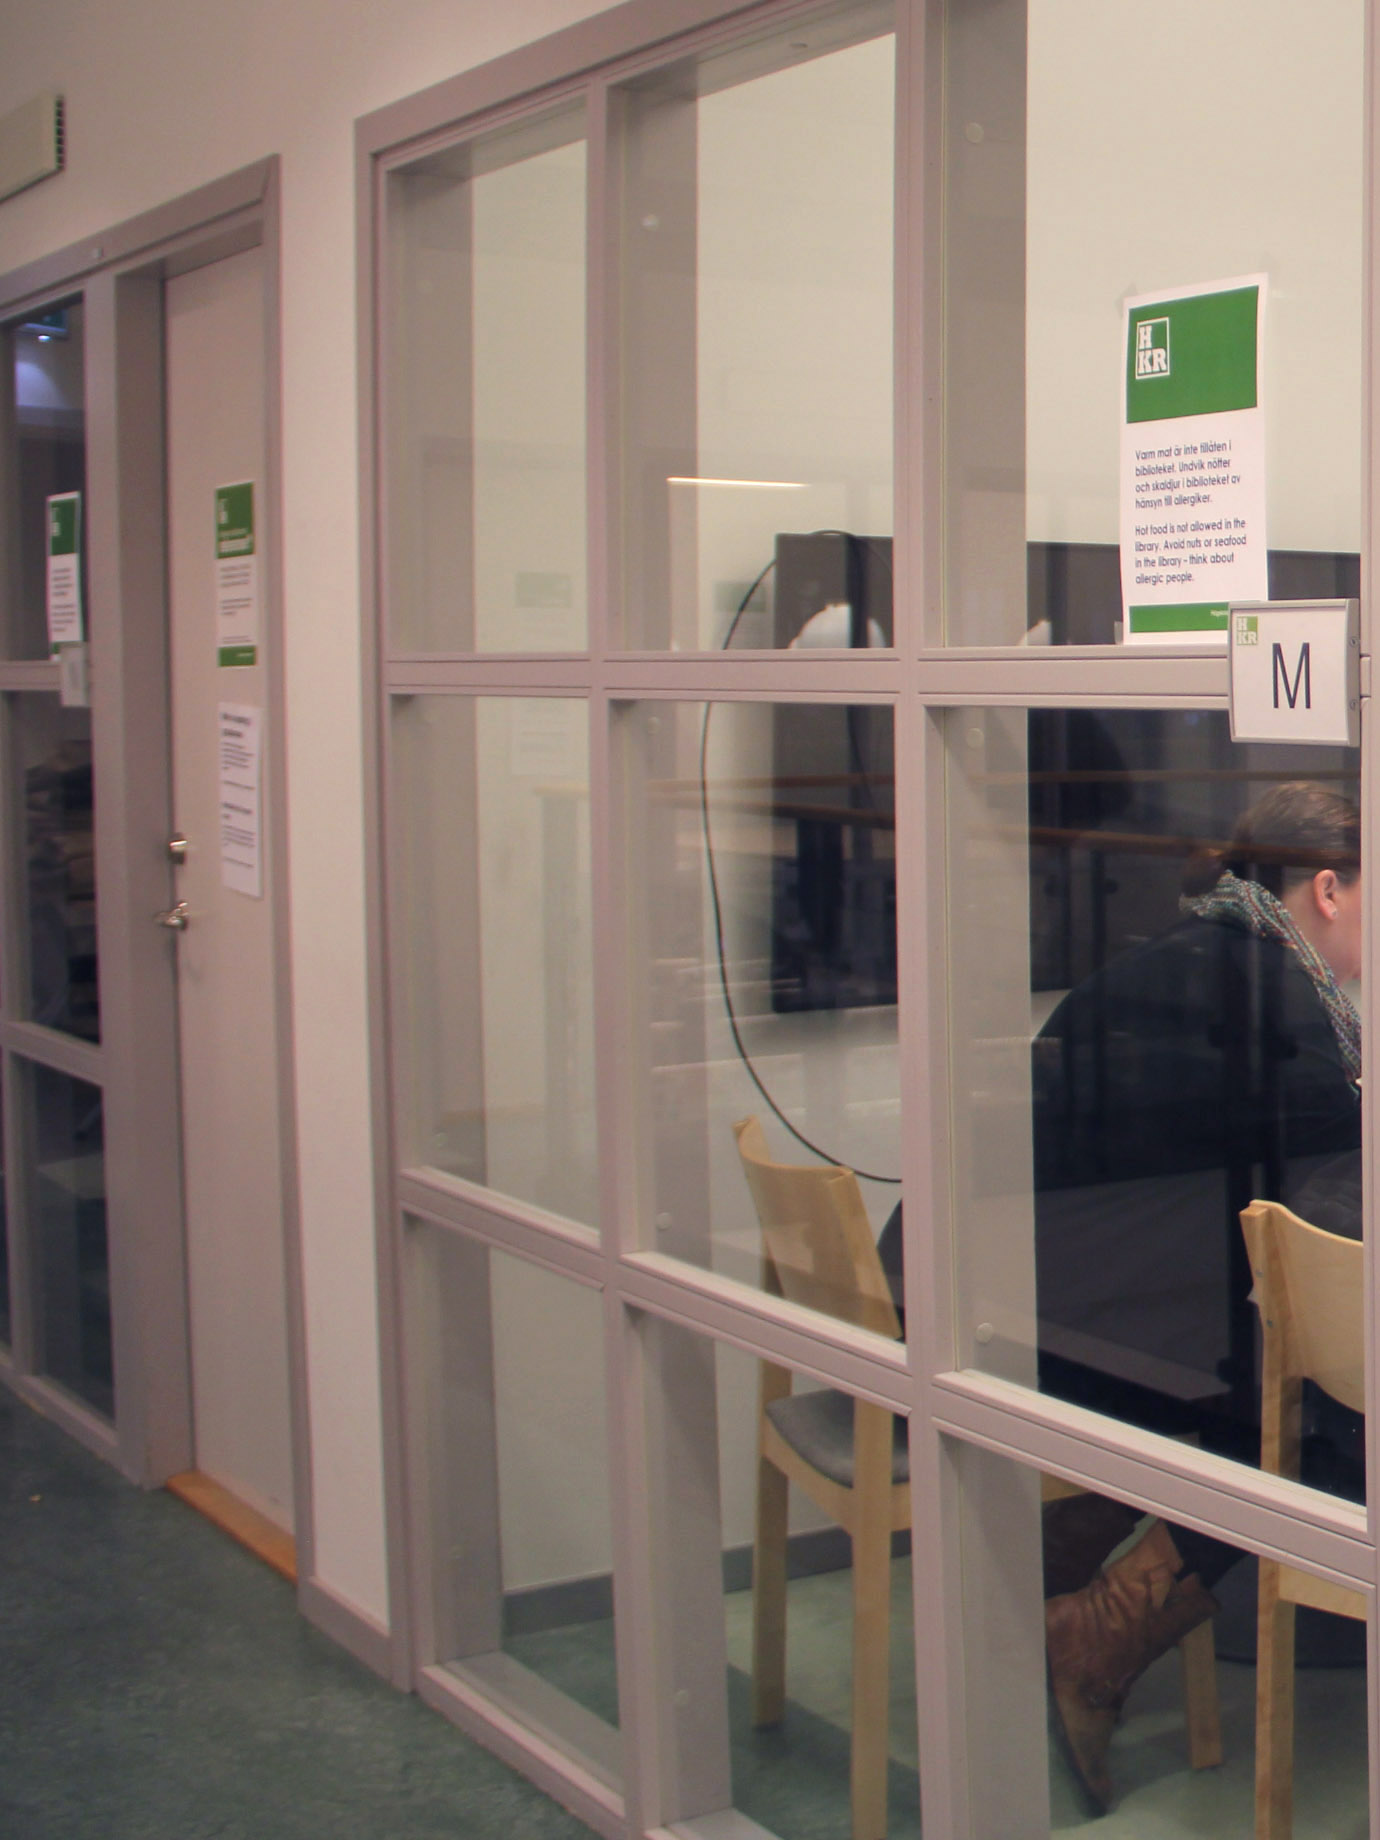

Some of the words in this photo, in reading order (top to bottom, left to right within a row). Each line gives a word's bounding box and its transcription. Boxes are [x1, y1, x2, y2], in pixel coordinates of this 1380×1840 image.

[1139, 325, 1152, 349] H
[1138, 348, 1167, 374] KR
[1135, 450, 1155, 460] Varm
[1157, 447, 1172, 458] mat
[1174, 445, 1181, 456] är
[1184, 444, 1198, 455] inte
[1200, 440, 1226, 453] tillåten
[1136, 463, 1176, 476] biblioteket.
[1179, 460, 1204, 472] Undvik
[1207, 458, 1230, 469] nötter
[1136, 483, 1150, 492] och
[1152, 479, 1180, 491] skaldjur
[1186, 474, 1229, 487] biblioteket
[1231, 475, 1240, 483] av
[1135, 498, 1162, 510] hänsyn
[1164, 495, 1172, 506] till
[1174, 493, 1212, 506] allergiker.
[1135, 525, 1148, 536] Hot
[1150, 523, 1167, 534] food
[1169, 523, 1174, 533] is
[1177, 522, 1188, 533] not
[1190, 519, 1222, 532] allowed
[1224, 519, 1231, 529] in
[1233, 517, 1245, 528] the
[1135, 541, 1162, 552] library.
[1164, 539, 1184, 550] Avoid
[1187, 538, 1201, 548] nuts
[1204, 538, 1211, 547] or
[1214, 534, 1246, 546] seafood
[1135, 557, 1141, 568] in
[1144, 556, 1155, 567] the
[1158, 556, 1181, 568] library
[1189, 554, 1207, 564] think
[1210, 552, 1234, 563] about
[1136, 573, 1163, 585] allergic
[1166, 571, 1194, 584] people.
[1272, 642, 1311, 709] M
